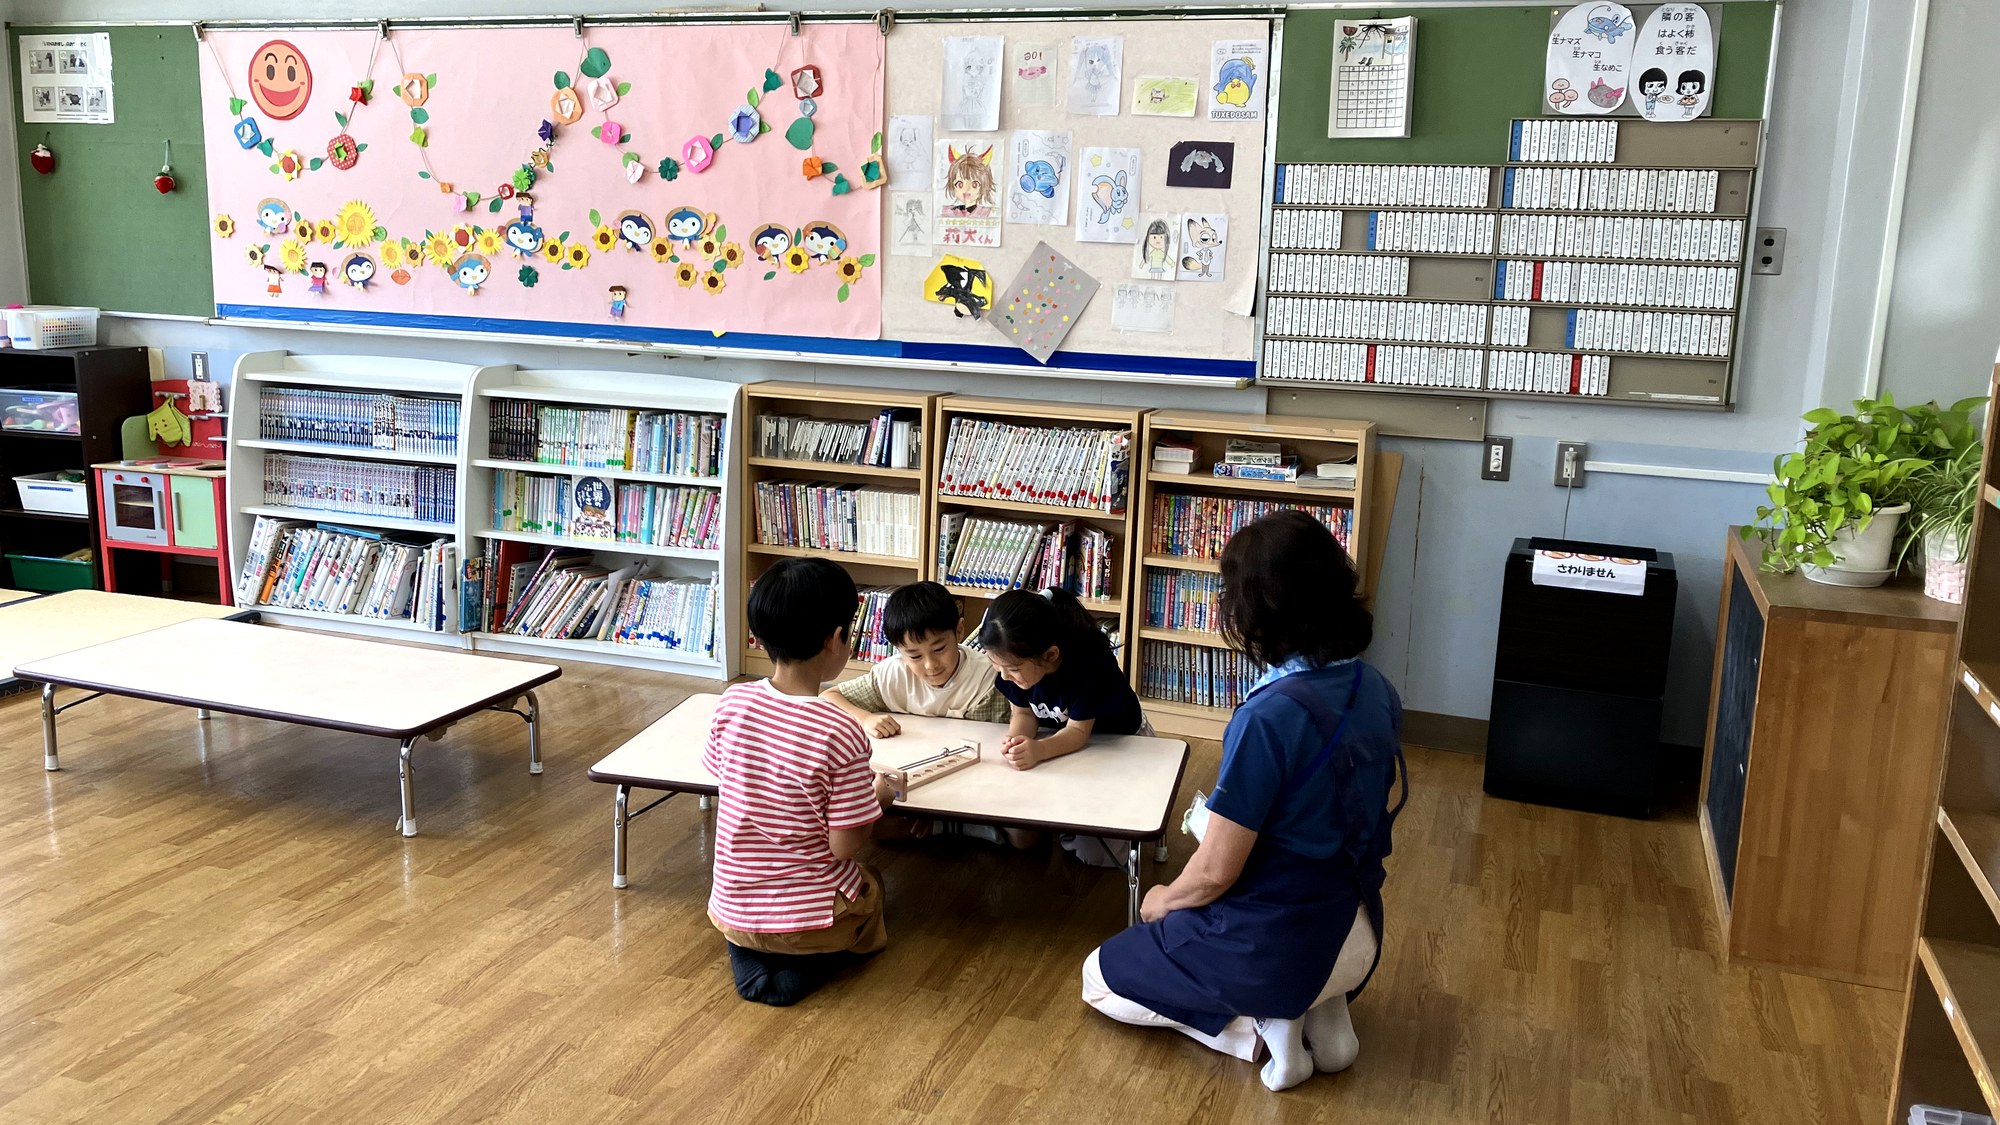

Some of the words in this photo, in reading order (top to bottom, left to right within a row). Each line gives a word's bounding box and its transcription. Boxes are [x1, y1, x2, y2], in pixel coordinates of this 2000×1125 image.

[1661, 12, 1695, 22] 隣の客
[1657, 29, 1695, 39] はよく柿
[1552, 37, 1582, 46] 生ナマズ
[1572, 50, 1601, 59] 生ナマコ
[1655, 45, 1697, 56] 食う客だ
[1593, 63, 1623, 72] 生なめこ
[1211, 110, 1258, 119] TUXEDOSAM
[1557, 564, 1616, 578] さわりません
